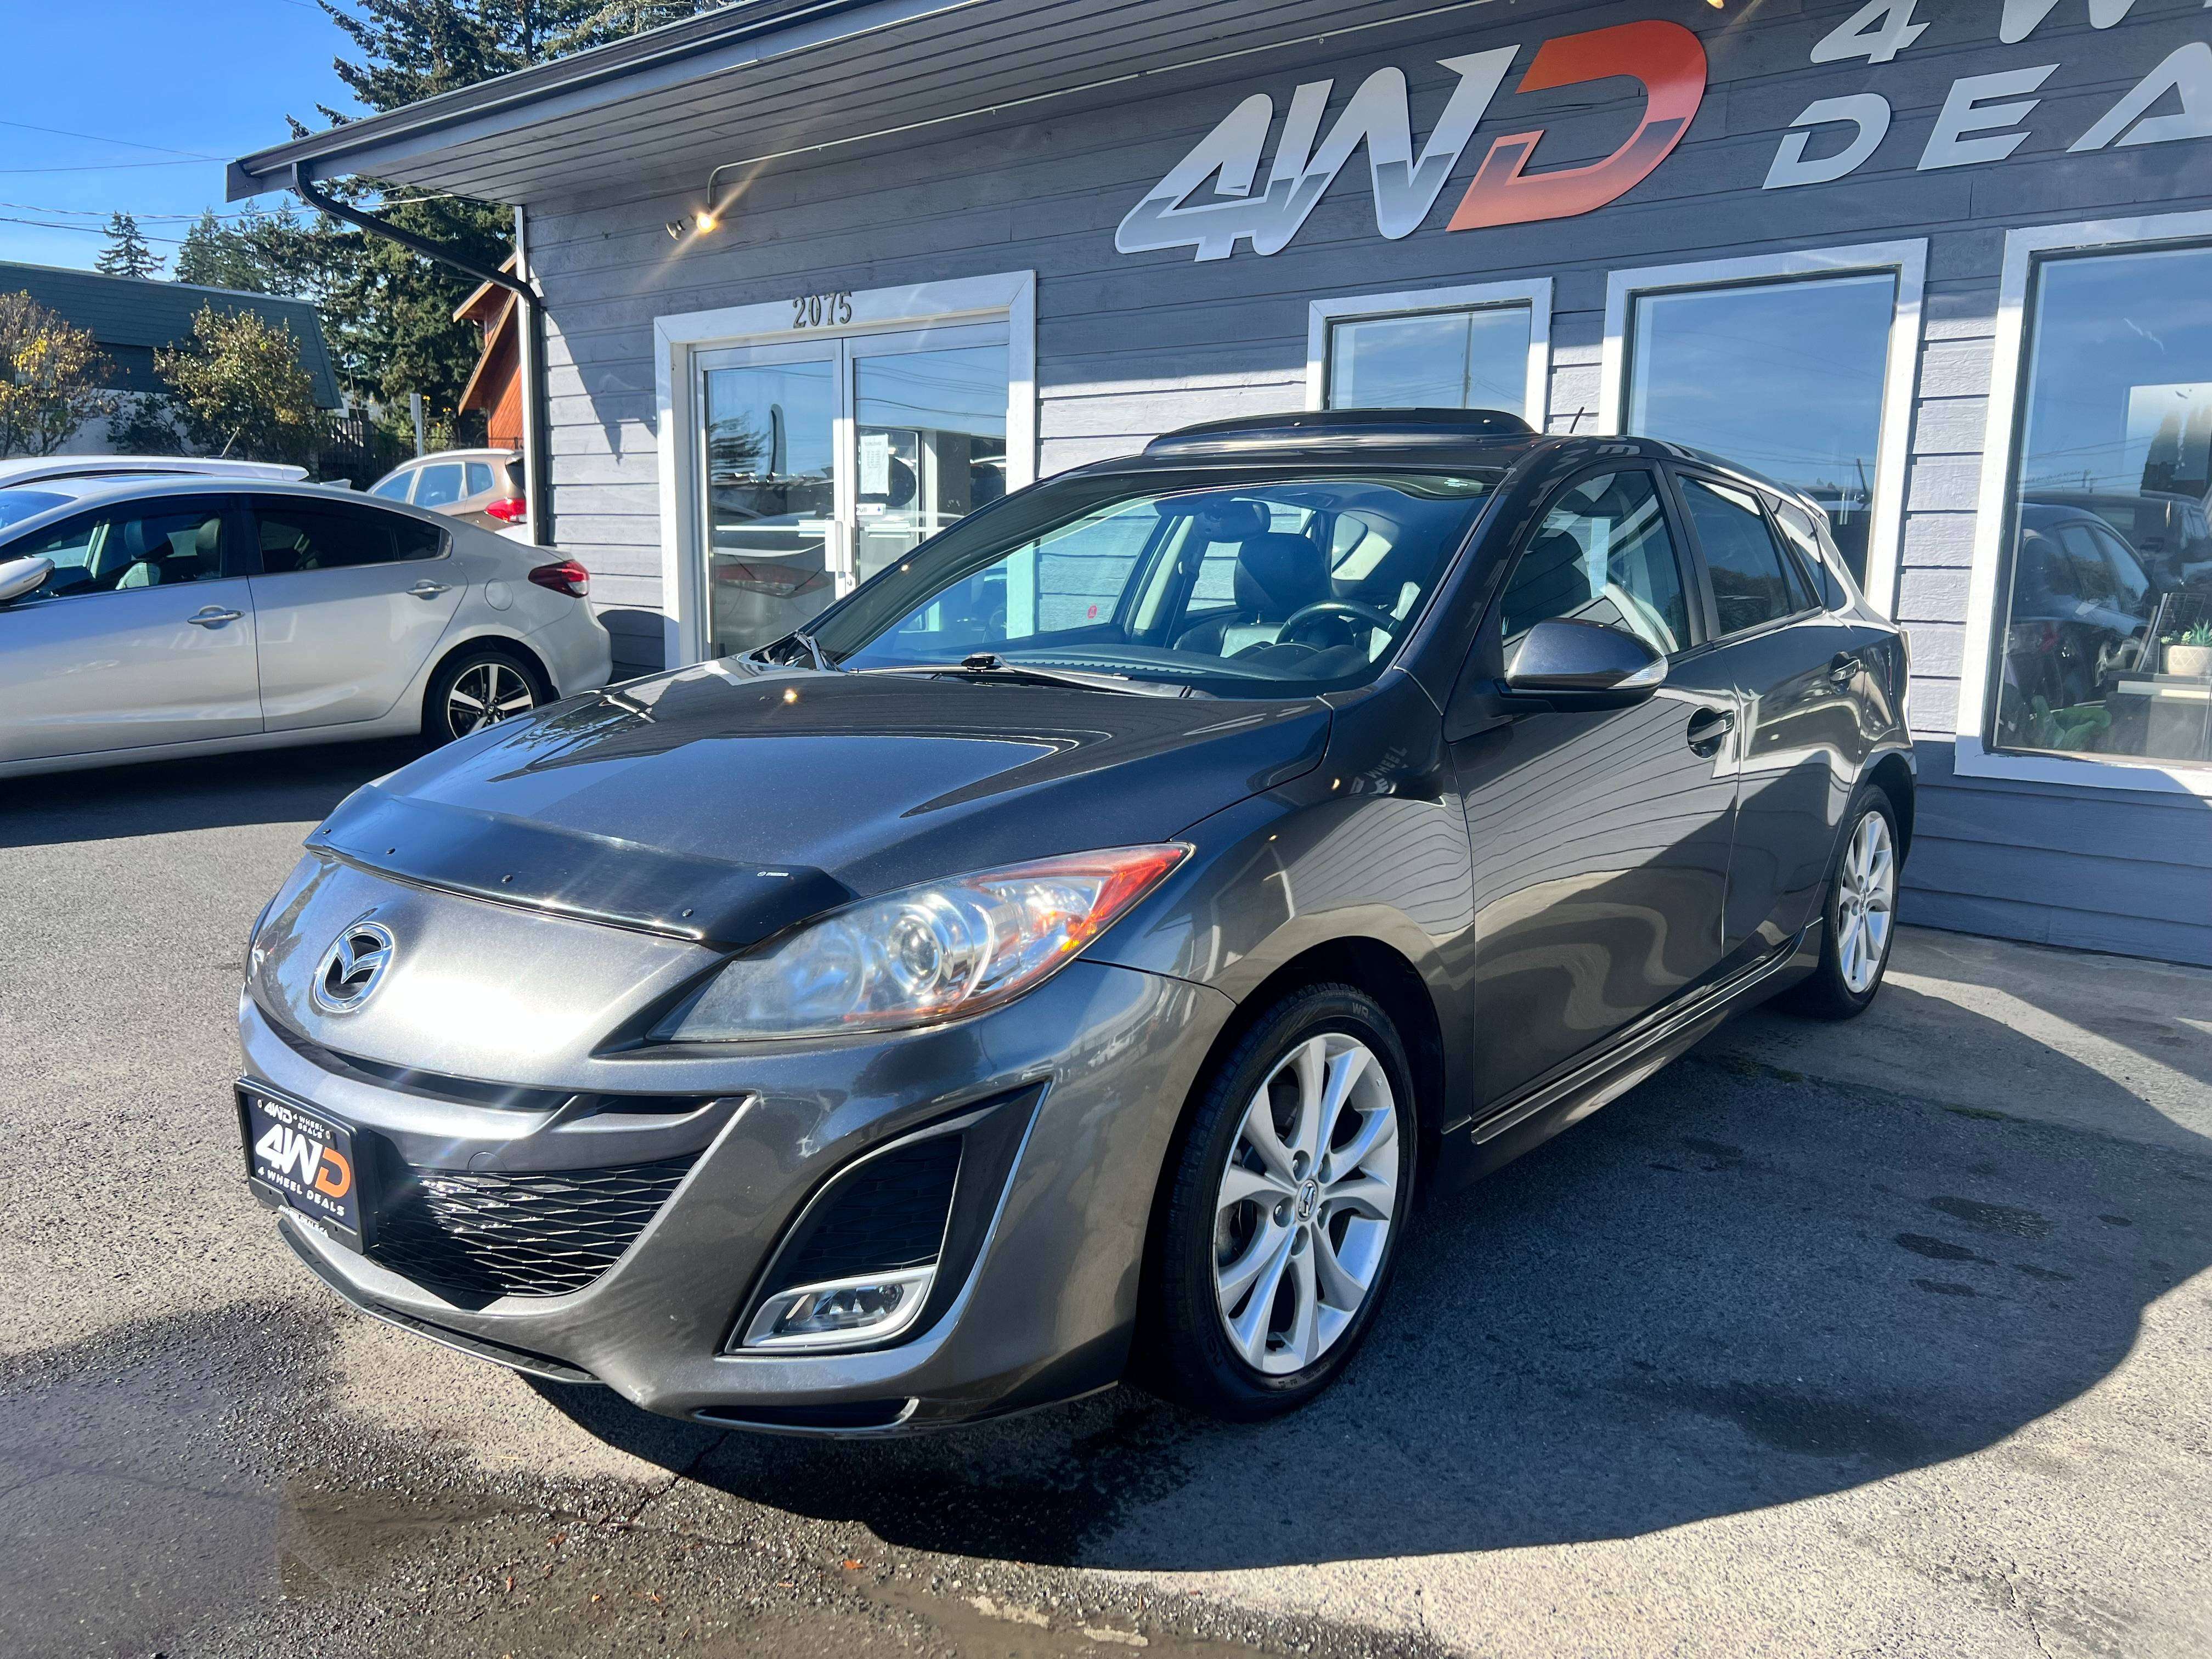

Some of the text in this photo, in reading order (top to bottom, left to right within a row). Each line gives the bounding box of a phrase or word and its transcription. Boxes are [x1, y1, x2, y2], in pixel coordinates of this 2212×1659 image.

[1810, 0, 1931, 64] 4
[792, 291, 852, 329] 2075
[299, 1115, 324, 1132] WHEEL
[255, 1124, 351, 1198] 4WD
[257, 1166, 345, 1216] 4 WHEEL DEALS
